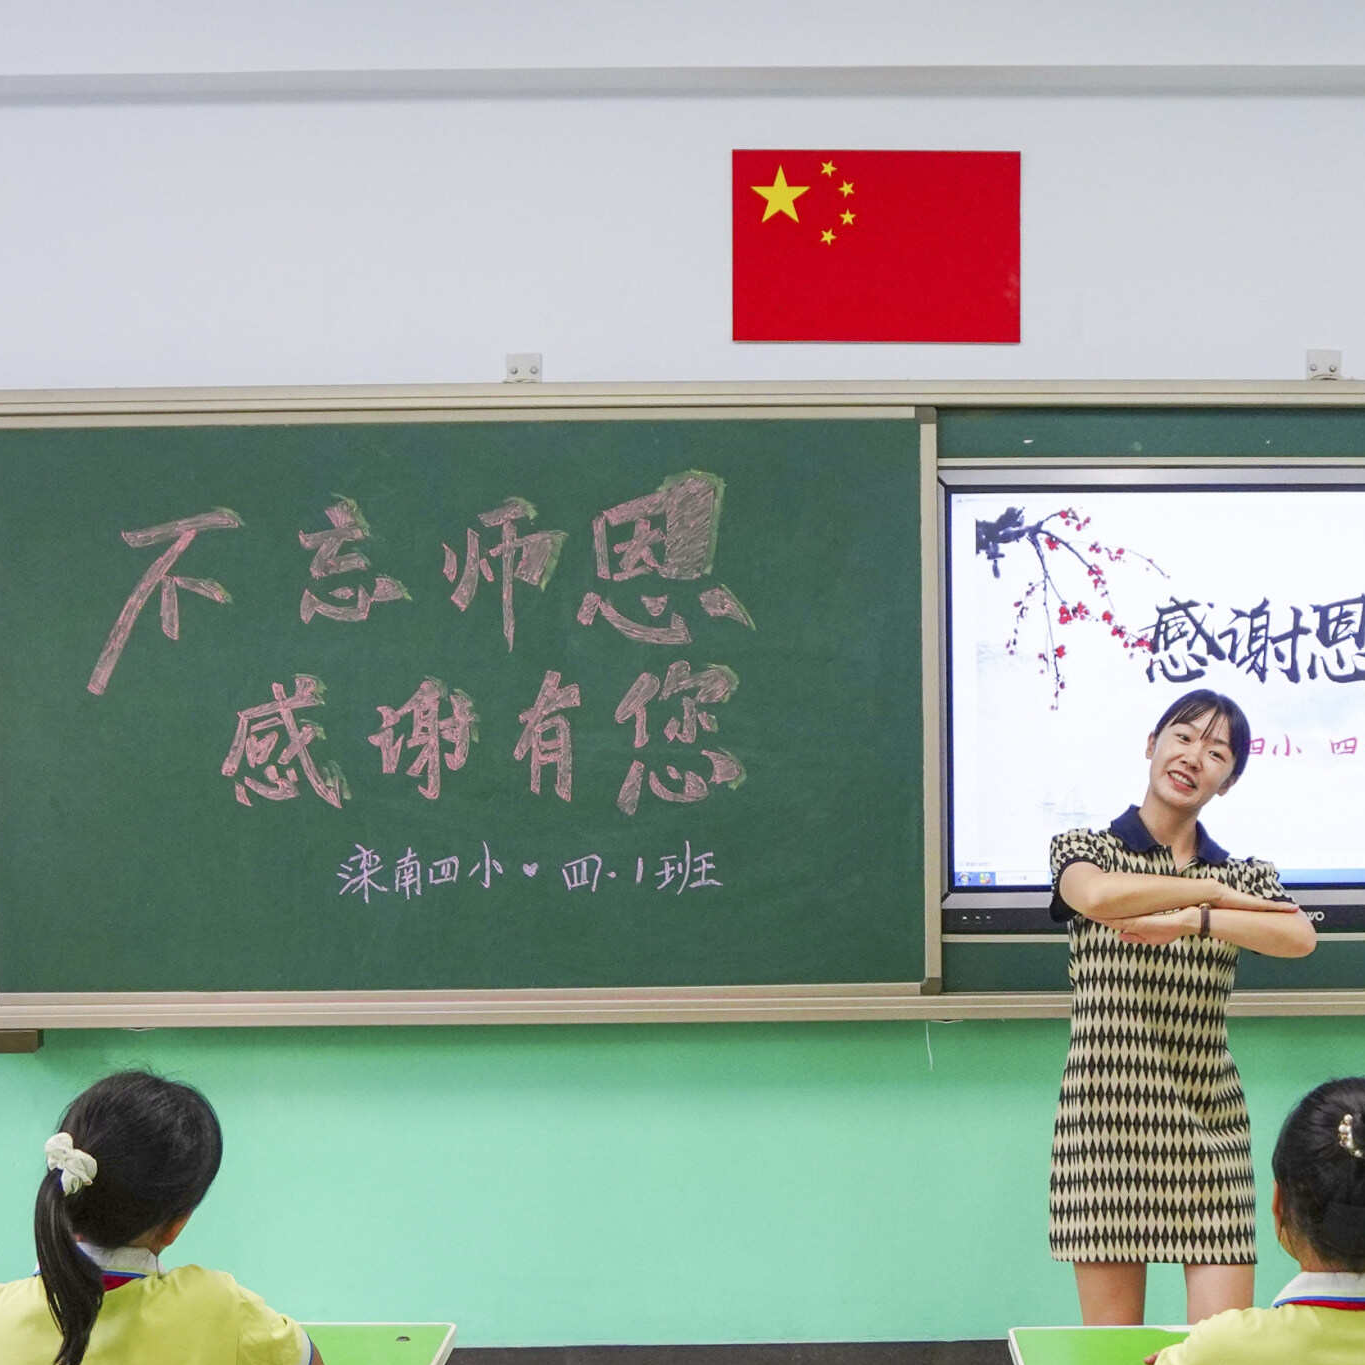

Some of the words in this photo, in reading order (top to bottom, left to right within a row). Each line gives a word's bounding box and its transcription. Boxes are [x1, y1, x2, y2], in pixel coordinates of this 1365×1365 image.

[86, 469, 756, 695] 不忘师恩
[221, 660, 748, 816] 感谢有您
[337, 840, 505, 903] 滦南四小
